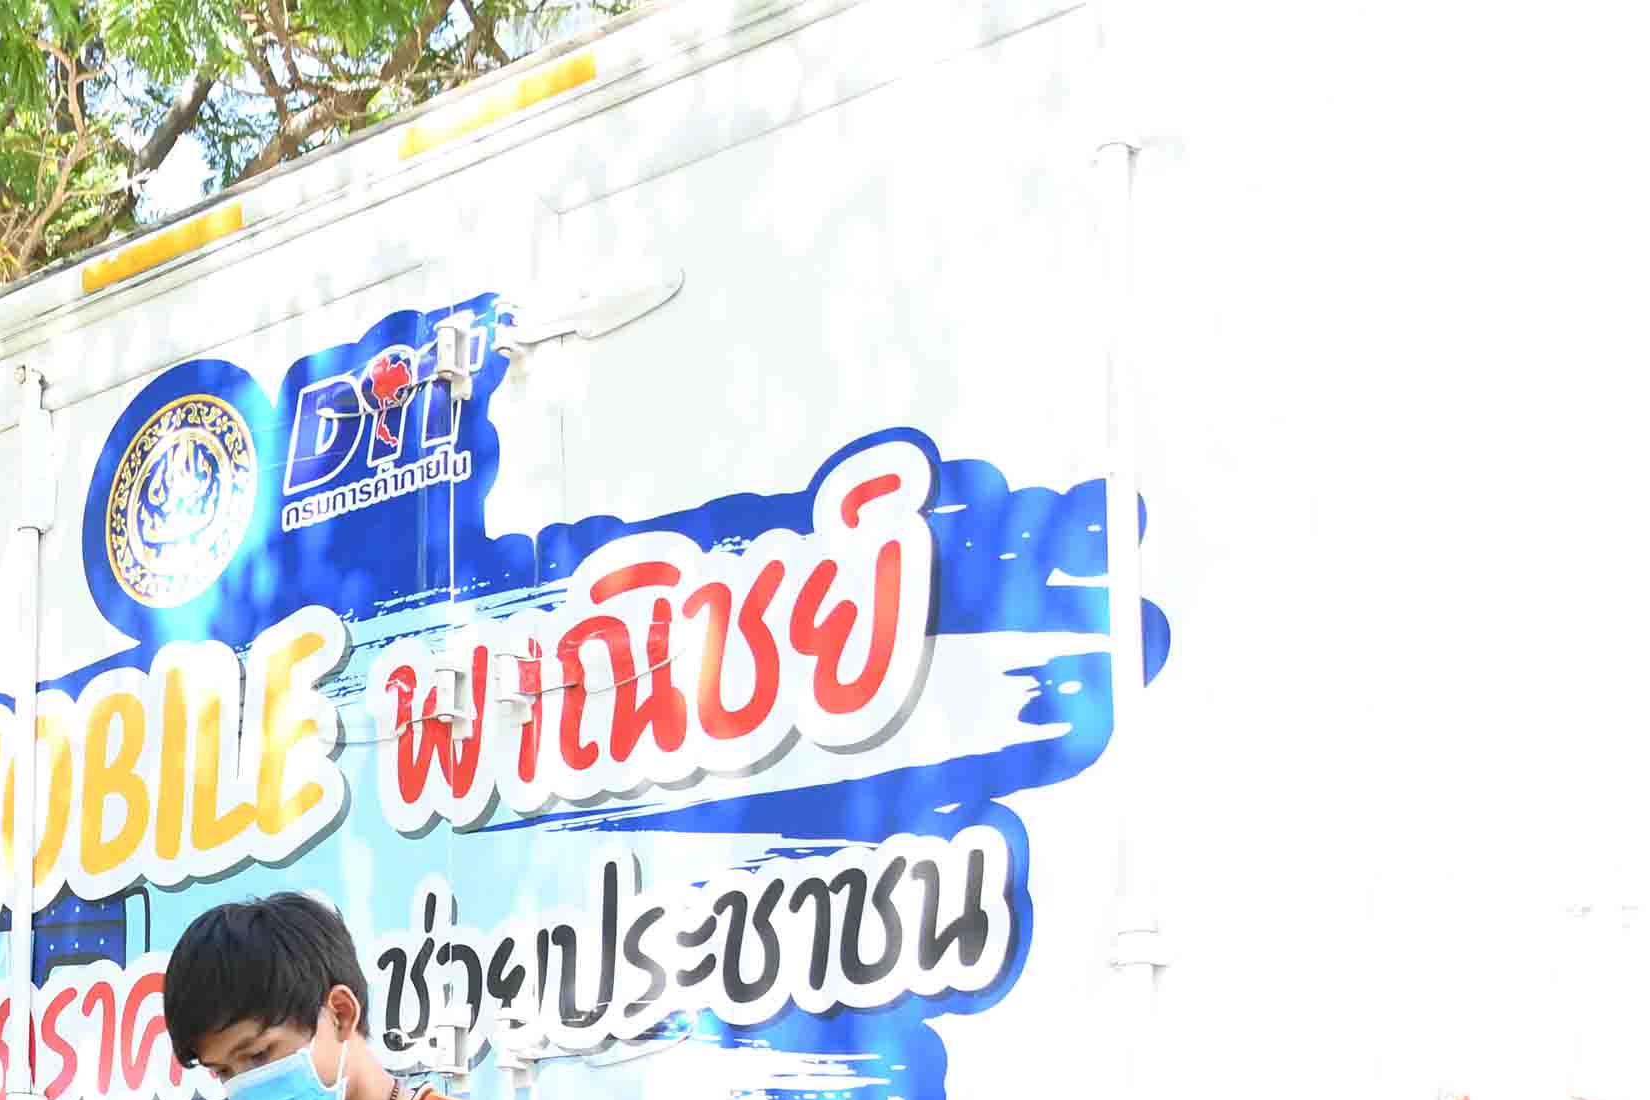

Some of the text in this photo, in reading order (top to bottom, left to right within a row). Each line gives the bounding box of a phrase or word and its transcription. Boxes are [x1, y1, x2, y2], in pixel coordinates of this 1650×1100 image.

[282, 447, 469, 529] กรมการค้าภายใน
[384, 472, 903, 806] พาณิชย์
